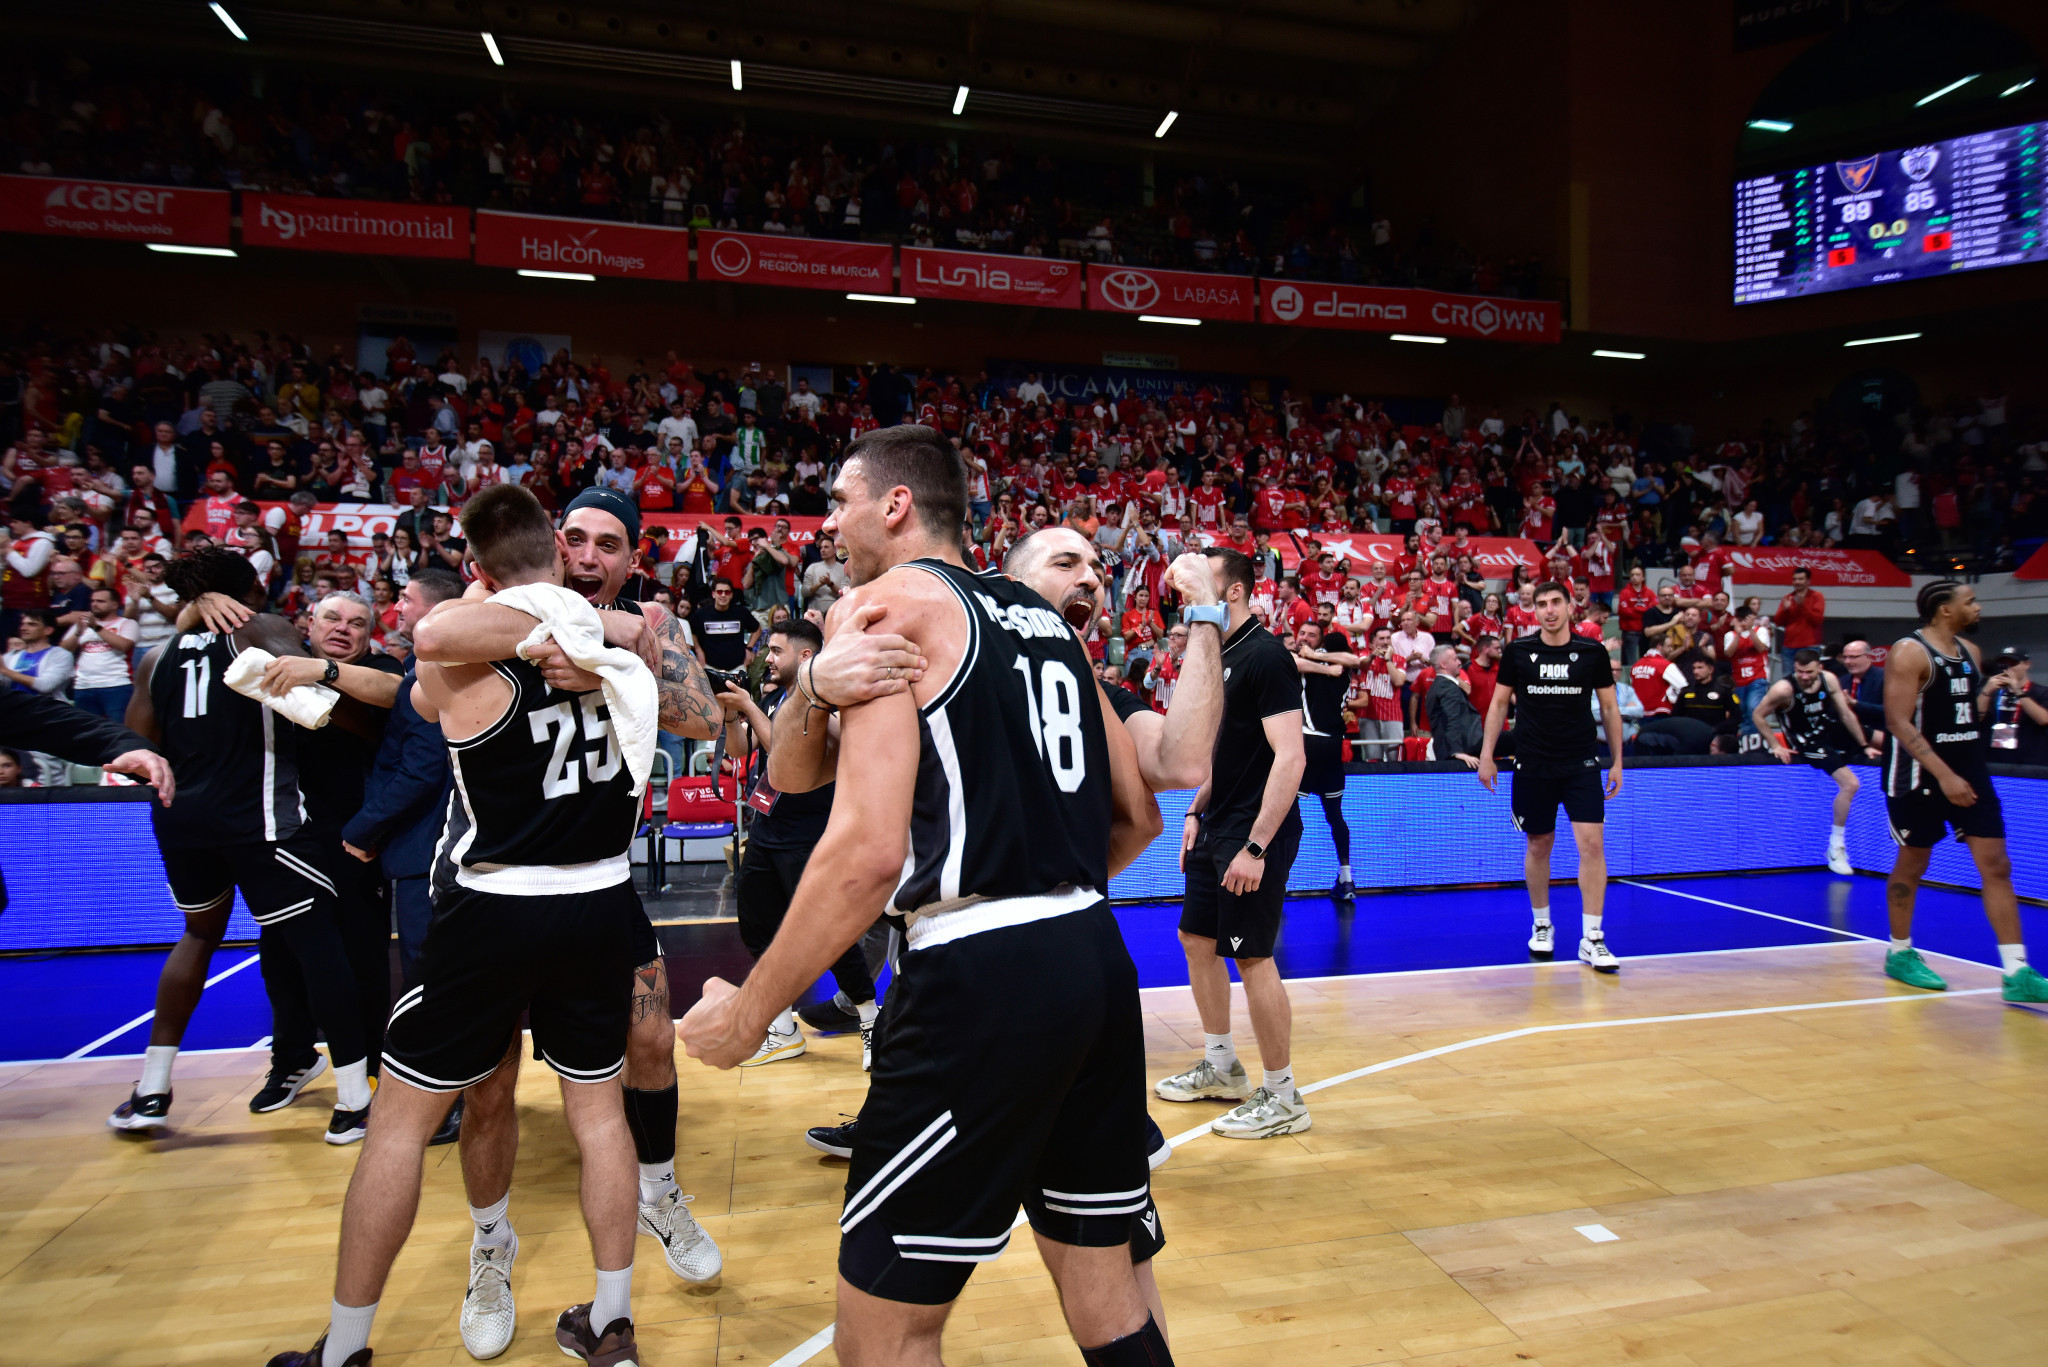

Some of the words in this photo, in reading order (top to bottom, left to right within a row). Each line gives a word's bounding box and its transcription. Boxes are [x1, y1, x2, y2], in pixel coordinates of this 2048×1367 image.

[70, 184, 174, 215] caser
[1841, 200, 1872, 224] 89
[1904, 188, 1938, 213] 85
[298, 210, 454, 241] patrimonial
[1868, 218, 1907, 240] 0.0
[811, 263, 827, 275] DE
[831, 265, 880, 278] MURCIA
[1173, 286, 1241, 305] LABASA
[1313, 290, 1407, 320] dama
[1431, 300, 1545, 336] CROWN
[1837, 572, 1876, 584] Murcia
[1539, 663, 1570, 678] PAOK
[179, 655, 211, 718] 11
[1012, 652, 1086, 793] 18
[527, 689, 622, 800] 25
